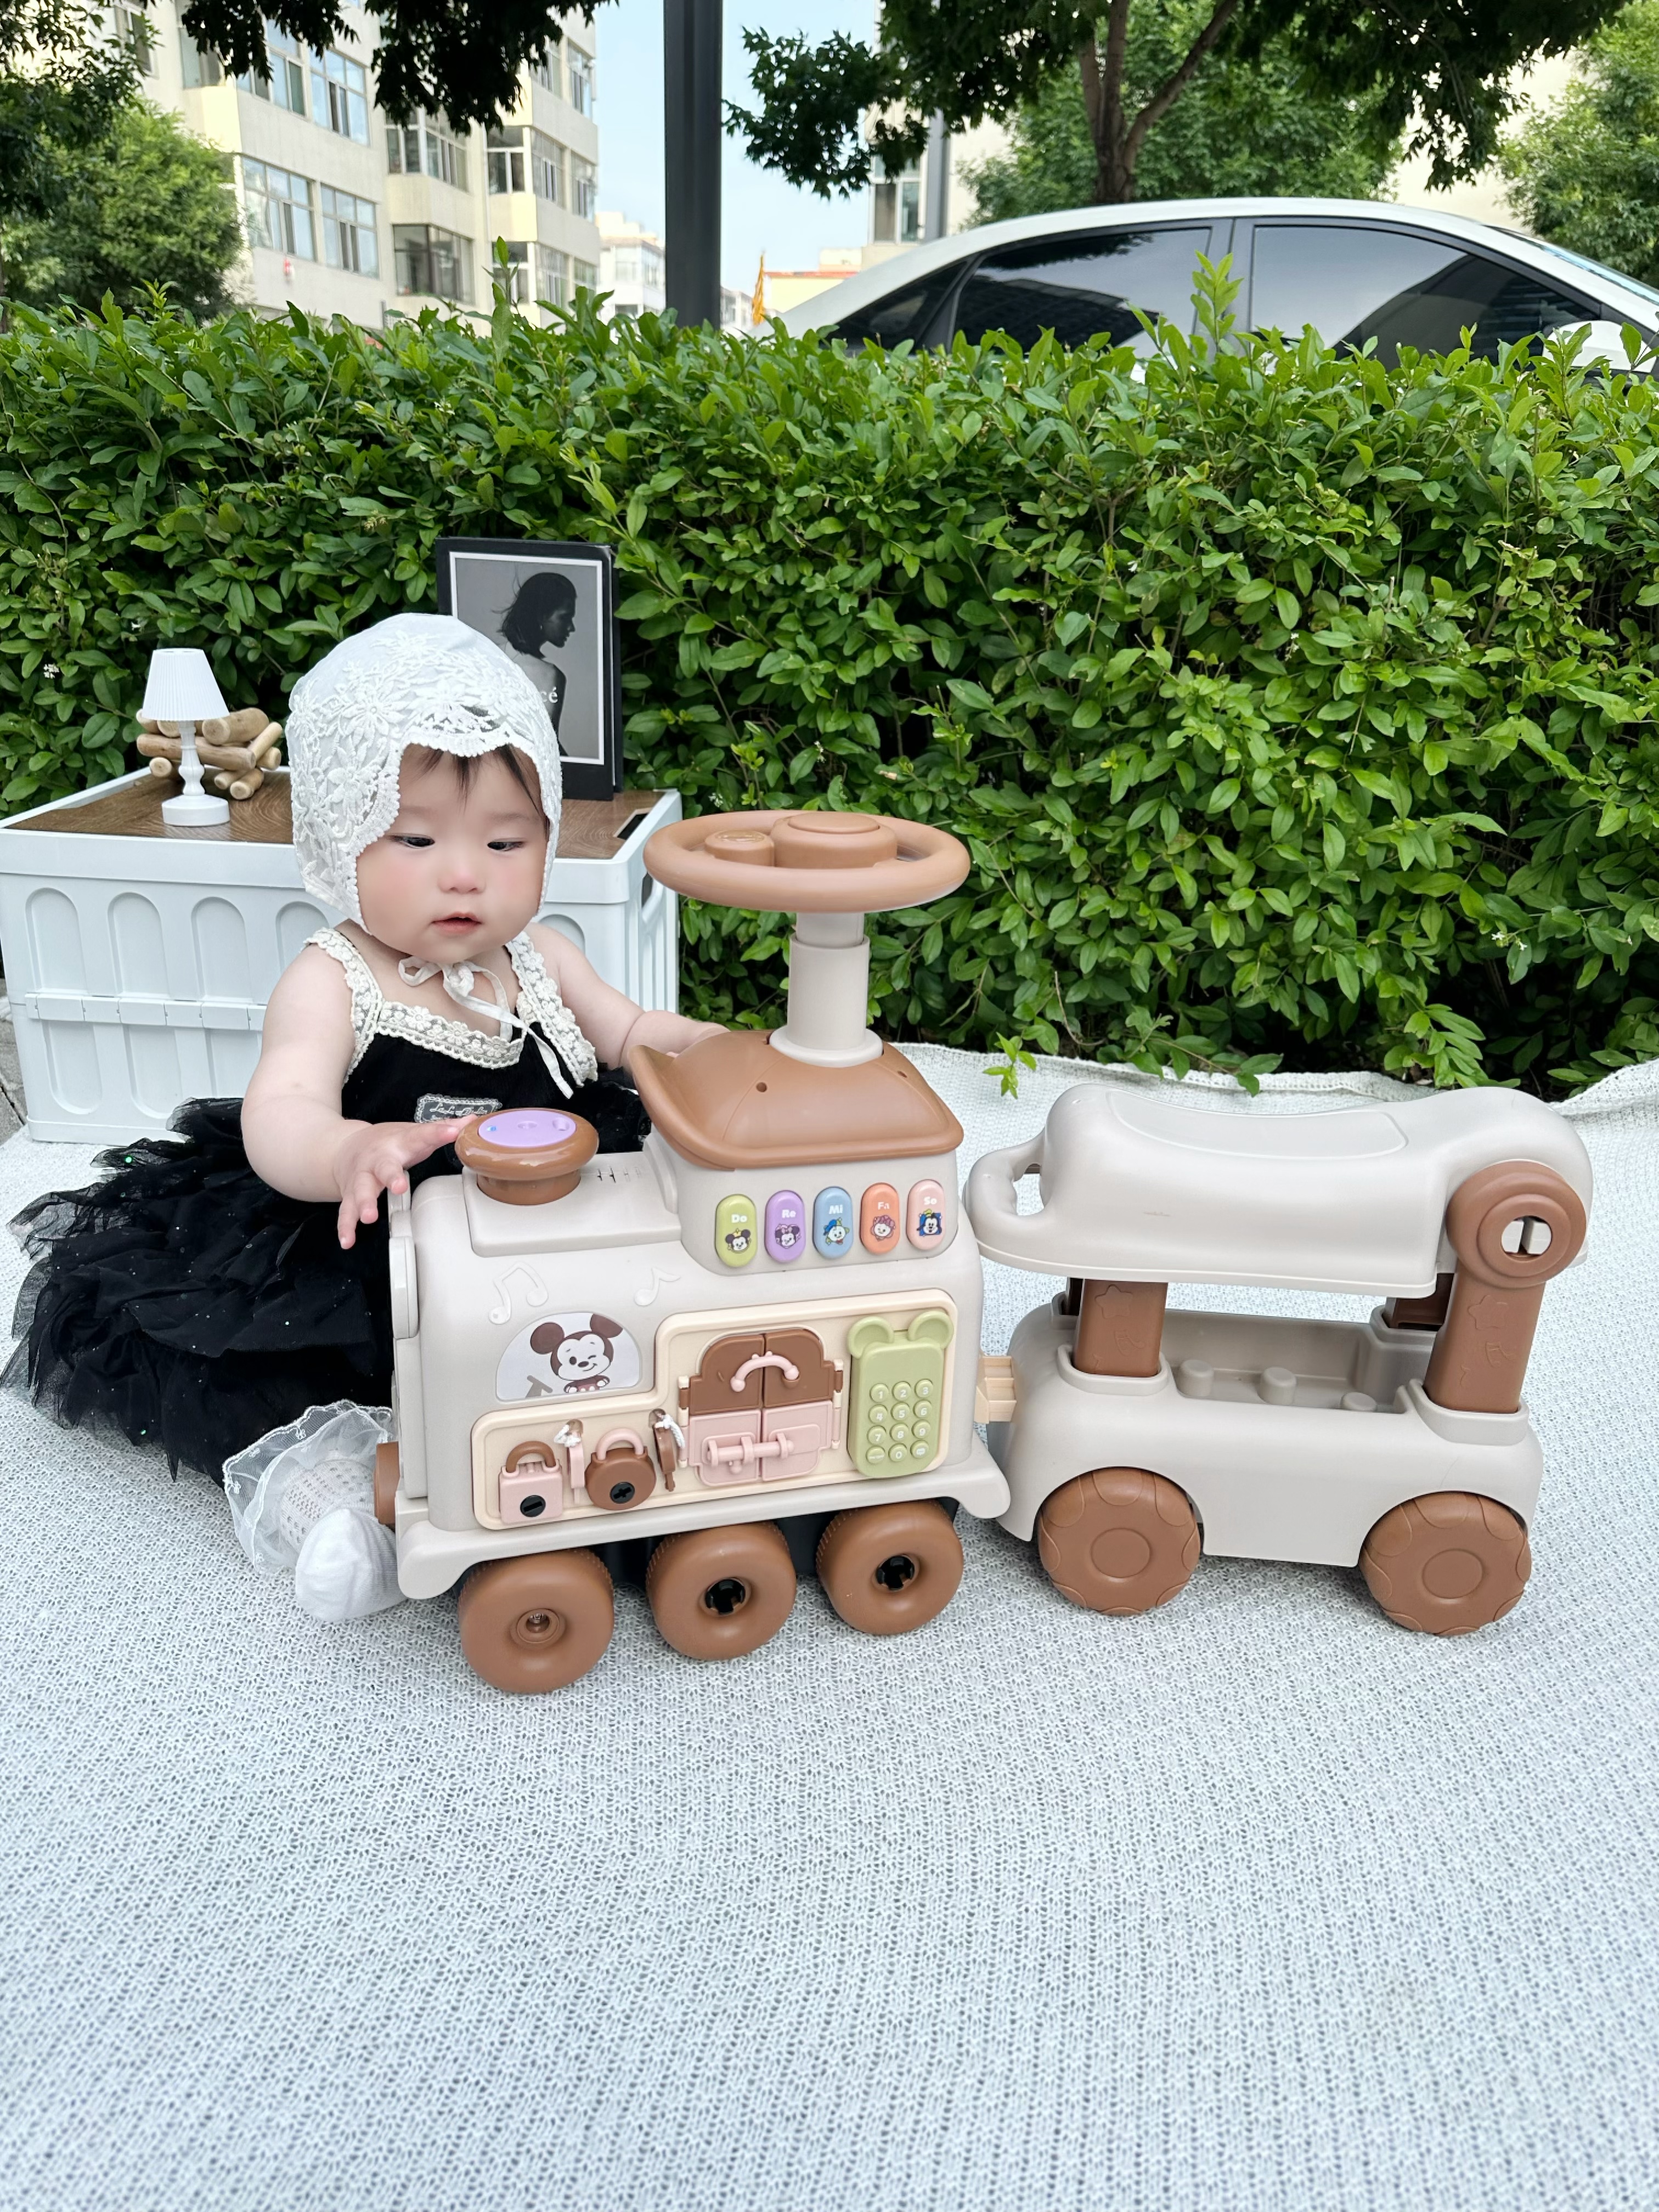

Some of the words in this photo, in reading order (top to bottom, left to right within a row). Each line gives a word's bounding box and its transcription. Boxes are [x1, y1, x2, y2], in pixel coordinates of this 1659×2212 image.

[731, 1214, 747, 1223] Do
[782, 1209, 797, 1218] Re
[828, 1205, 843, 1215] Mi
[878, 1201, 890, 1210] Fa
[924, 1196, 938, 1205] So
[879, 1391, 883, 1399] 1
[900, 1389, 906, 1397] 2
[876, 1413, 883, 1421] 4
[899, 1410, 905, 1418] 5
[919, 1428, 926, 1436] 9
[895, 1451, 902, 1459] 0
